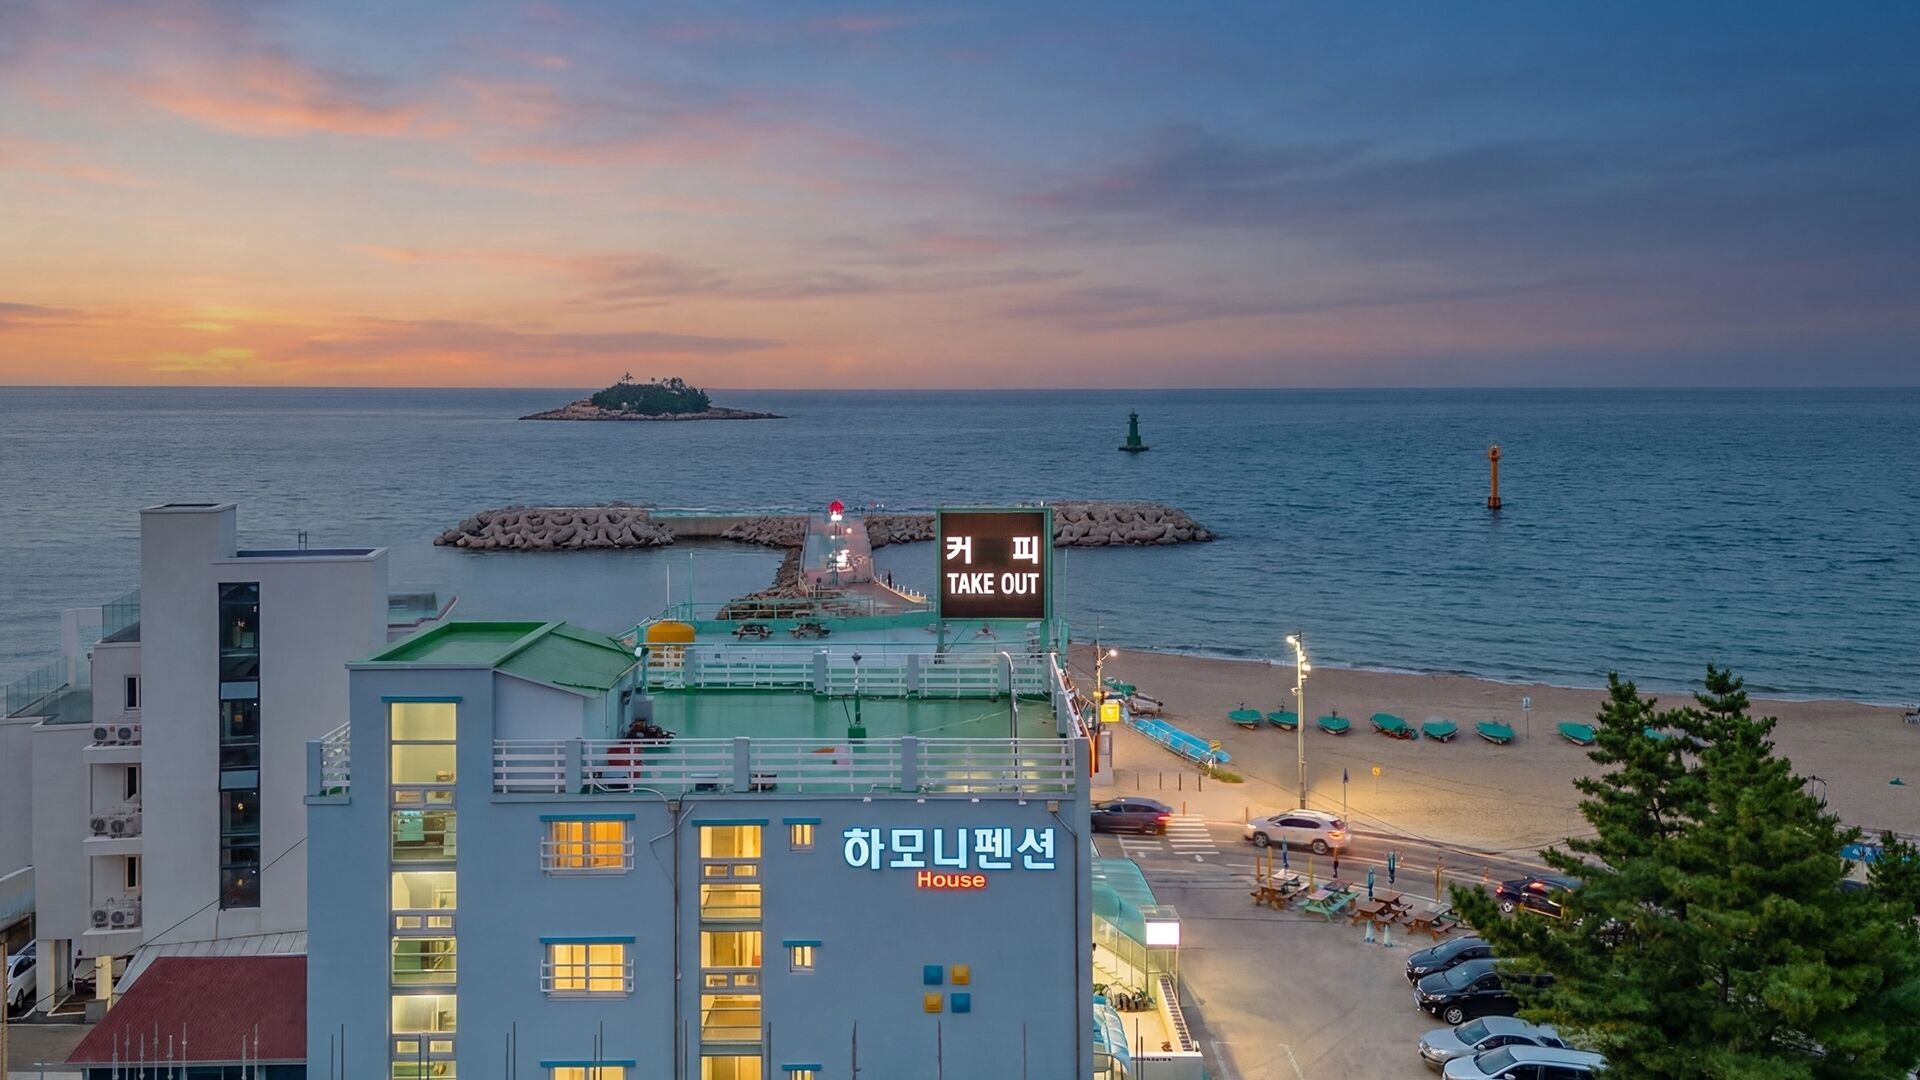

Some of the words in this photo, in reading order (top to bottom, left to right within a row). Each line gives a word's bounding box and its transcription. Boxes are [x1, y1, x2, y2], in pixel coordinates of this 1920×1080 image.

[947, 573, 995, 595] TAKE
[1001, 572, 1039, 595] OUT
[843, 828, 1055, 870] 하모니펜션
[917, 871, 986, 888] House
